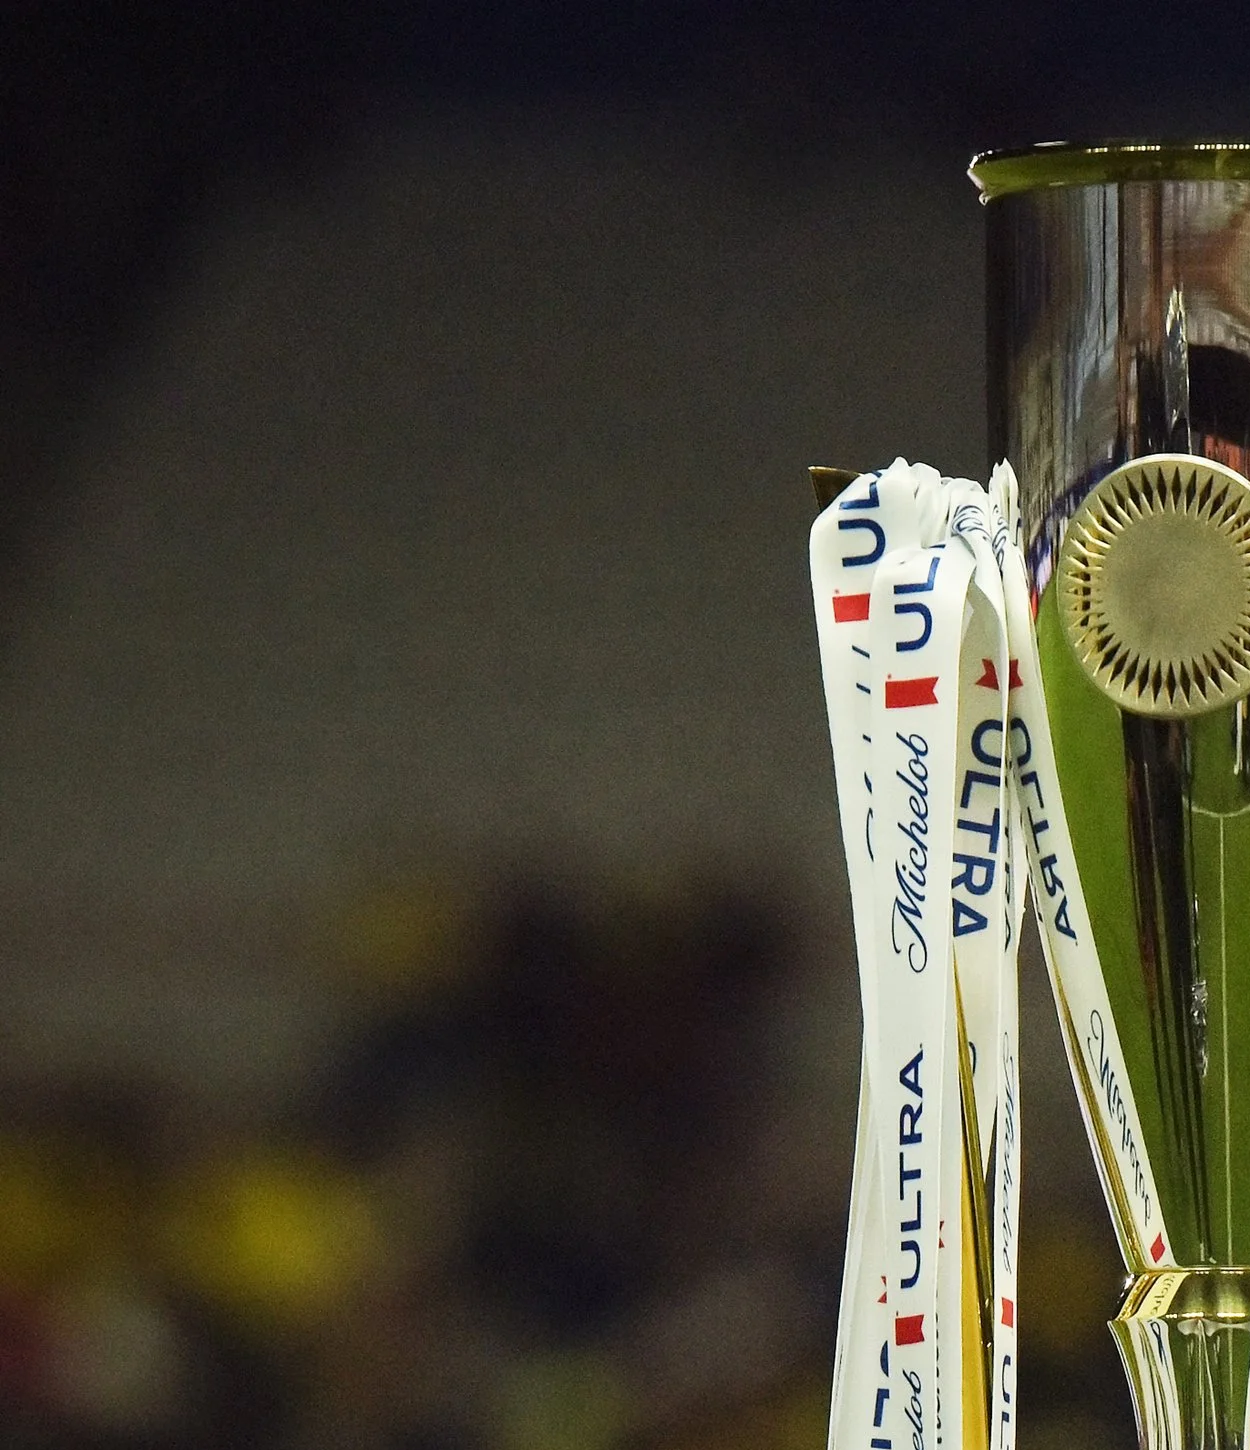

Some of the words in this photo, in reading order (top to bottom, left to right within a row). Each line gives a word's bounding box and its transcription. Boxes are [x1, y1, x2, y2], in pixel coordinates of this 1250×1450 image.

[892, 731, 929, 974] Michelob
[952, 717, 1003, 938] ULTRA
[899, 1049, 925, 1291] ULTRA
